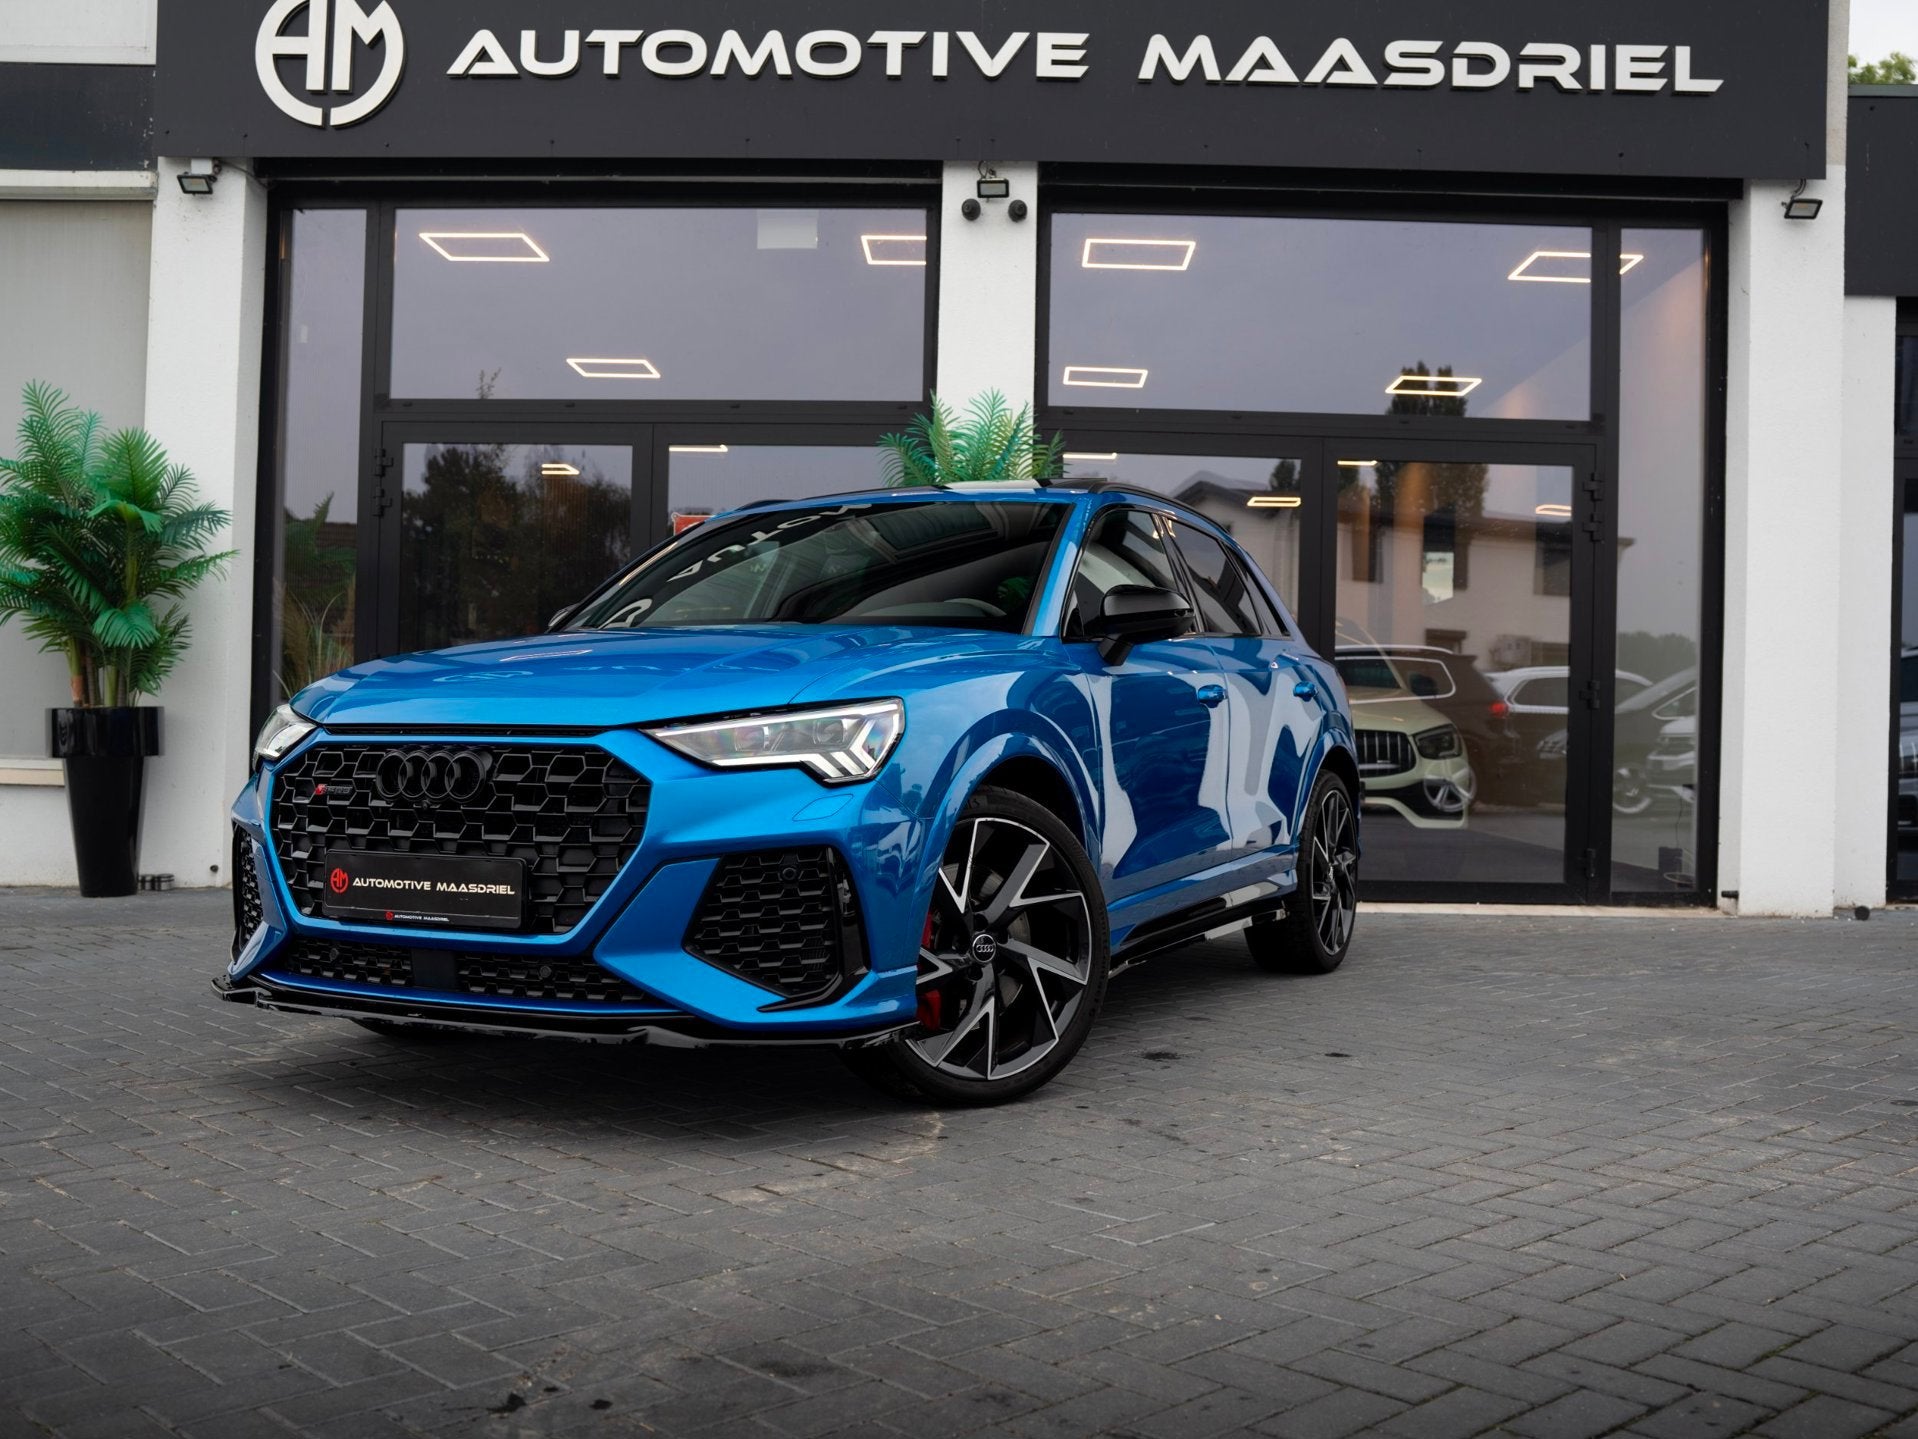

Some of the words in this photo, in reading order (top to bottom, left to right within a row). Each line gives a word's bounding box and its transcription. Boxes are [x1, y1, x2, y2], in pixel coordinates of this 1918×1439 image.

[446, 29, 1090, 78] AUTOMOTIVE
[1138, 33, 1724, 92] MAASDRIEL
[353, 877, 431, 891] AUTOMOTIVE
[436, 883, 515, 895] MAASDRIEL
